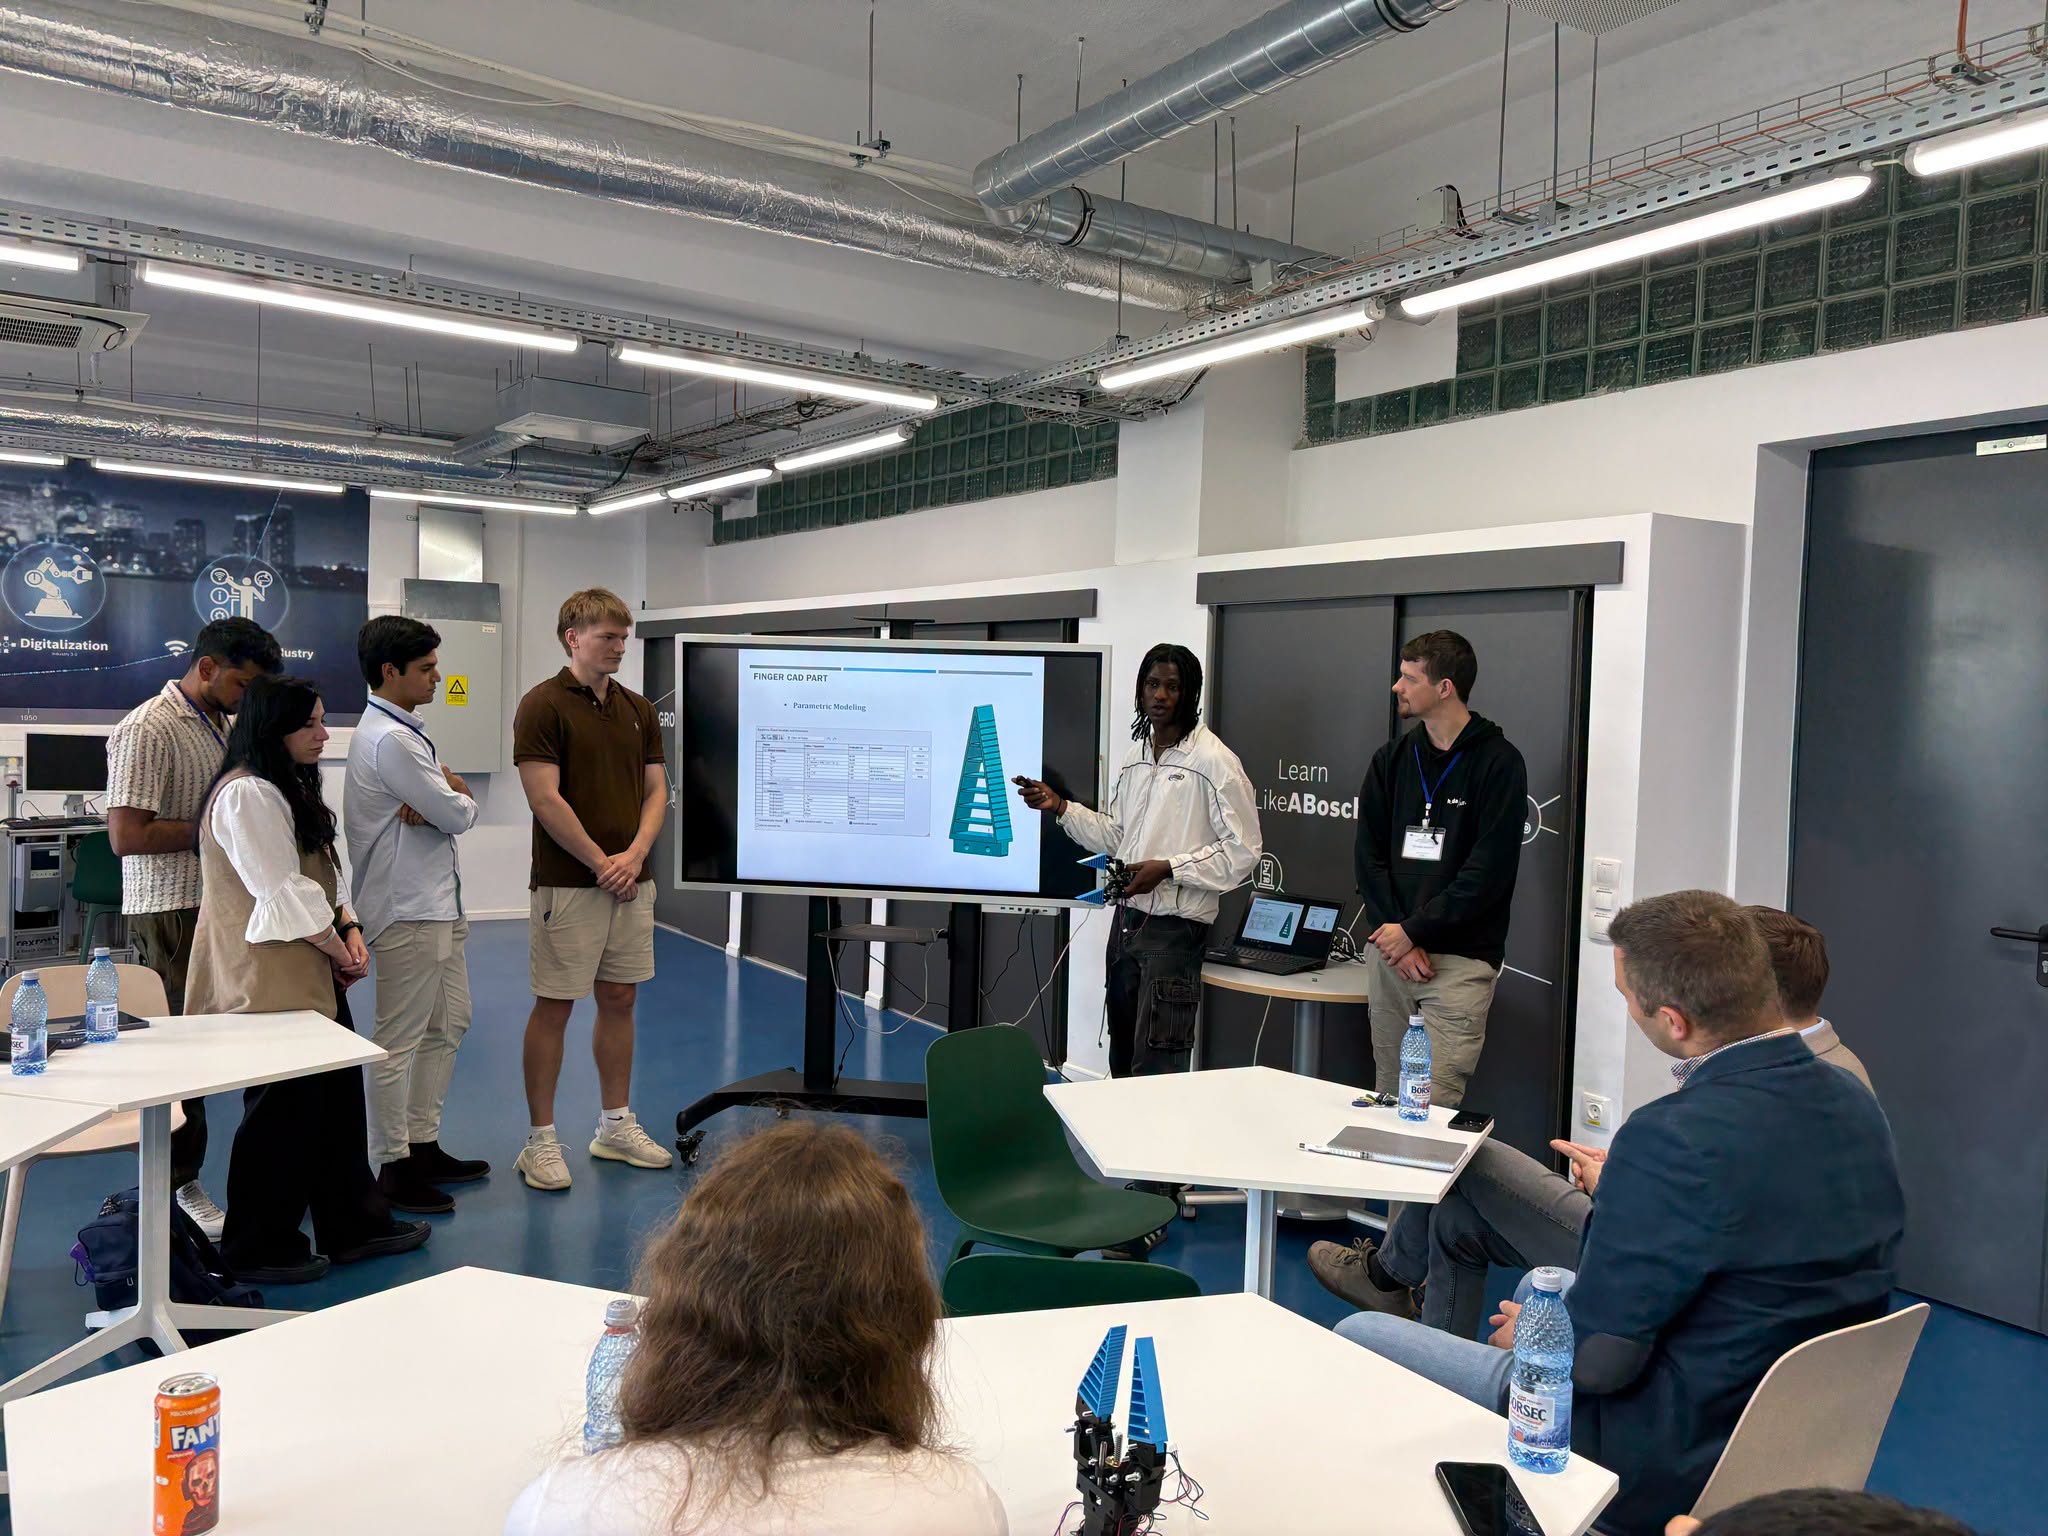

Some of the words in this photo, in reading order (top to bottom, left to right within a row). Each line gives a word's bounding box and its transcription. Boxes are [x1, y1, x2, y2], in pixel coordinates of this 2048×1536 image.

[20, 638, 109, 651] Digitalization
[753, 672, 784, 681] FINGER
[786, 673, 804, 682] CAD
[806, 674, 829, 683] PART
[793, 702, 832, 710] Parametric
[833, 703, 867, 713] Modeling
[1278, 759, 1329, 783] Learn
[1511, 1396, 1547, 1422] ORSEC
